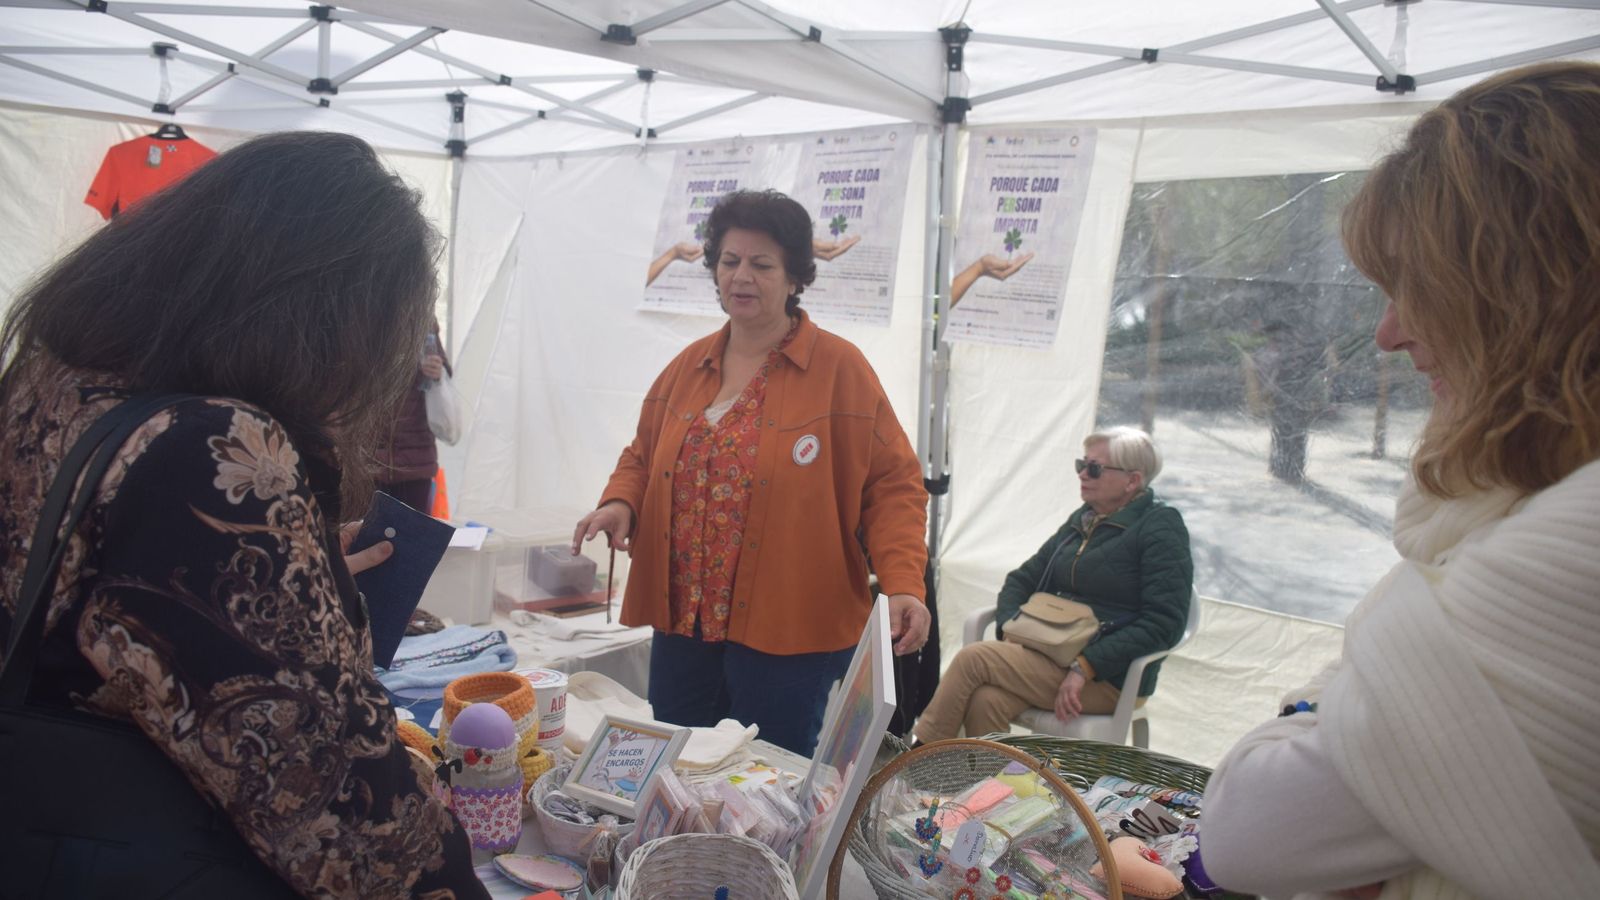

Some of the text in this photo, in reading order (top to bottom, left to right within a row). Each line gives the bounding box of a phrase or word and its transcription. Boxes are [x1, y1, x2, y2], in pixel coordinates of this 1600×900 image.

[817, 168, 880, 184] PORQUE CADA
[686, 179, 738, 193] PORQUE CADA
[990, 176, 1059, 192] PORQUE CADA
[823, 187, 865, 201] PERSONA
[820, 205, 863, 219] IMPORTA
[997, 197, 1042, 213] PERSONA
[993, 218, 1038, 233] IMPORTA
[618, 748, 644, 757] HACEN
[606, 758, 645, 768] ENCARGOS
